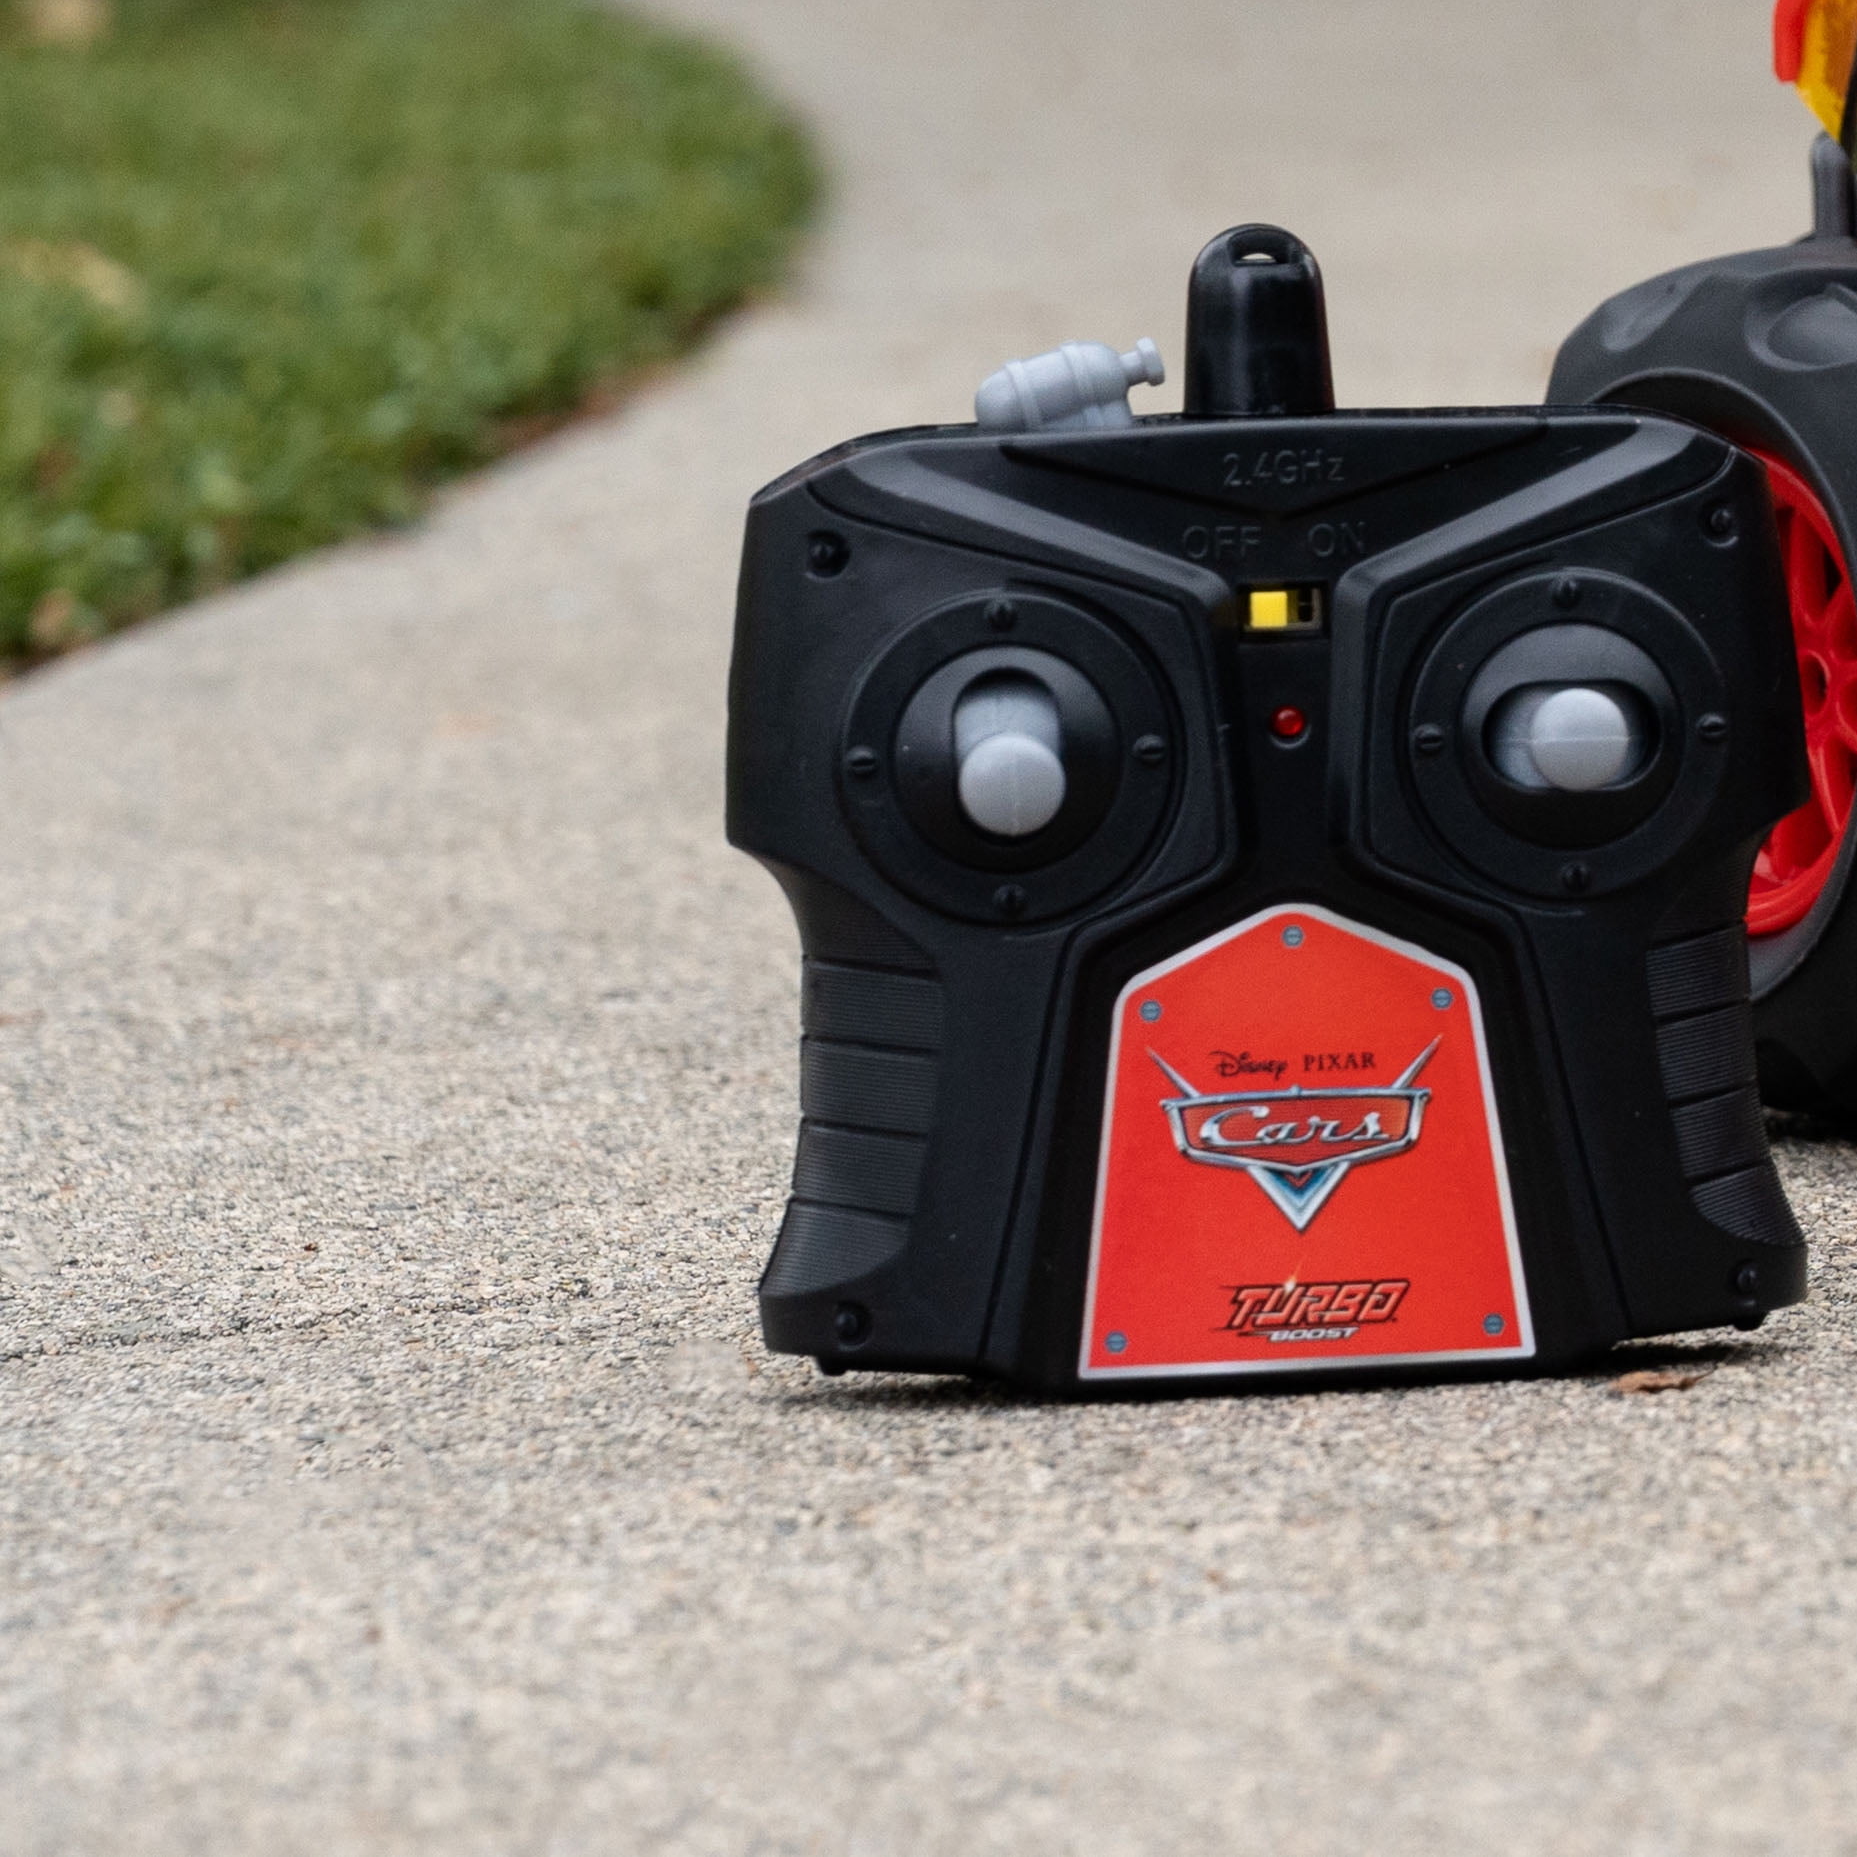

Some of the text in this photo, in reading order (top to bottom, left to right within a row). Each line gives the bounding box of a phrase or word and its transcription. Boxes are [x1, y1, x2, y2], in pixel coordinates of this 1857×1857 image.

[1223, 449, 1345, 487] 2.4GHz
[1183, 521, 1366, 559] OFF ON
[1303, 1052, 1376, 1072] PIXAR
[1199, 1105, 1389, 1147] Cars
[1225, 1279, 1409, 1330] TURBO
[1267, 1327, 1360, 1343] BOOST
